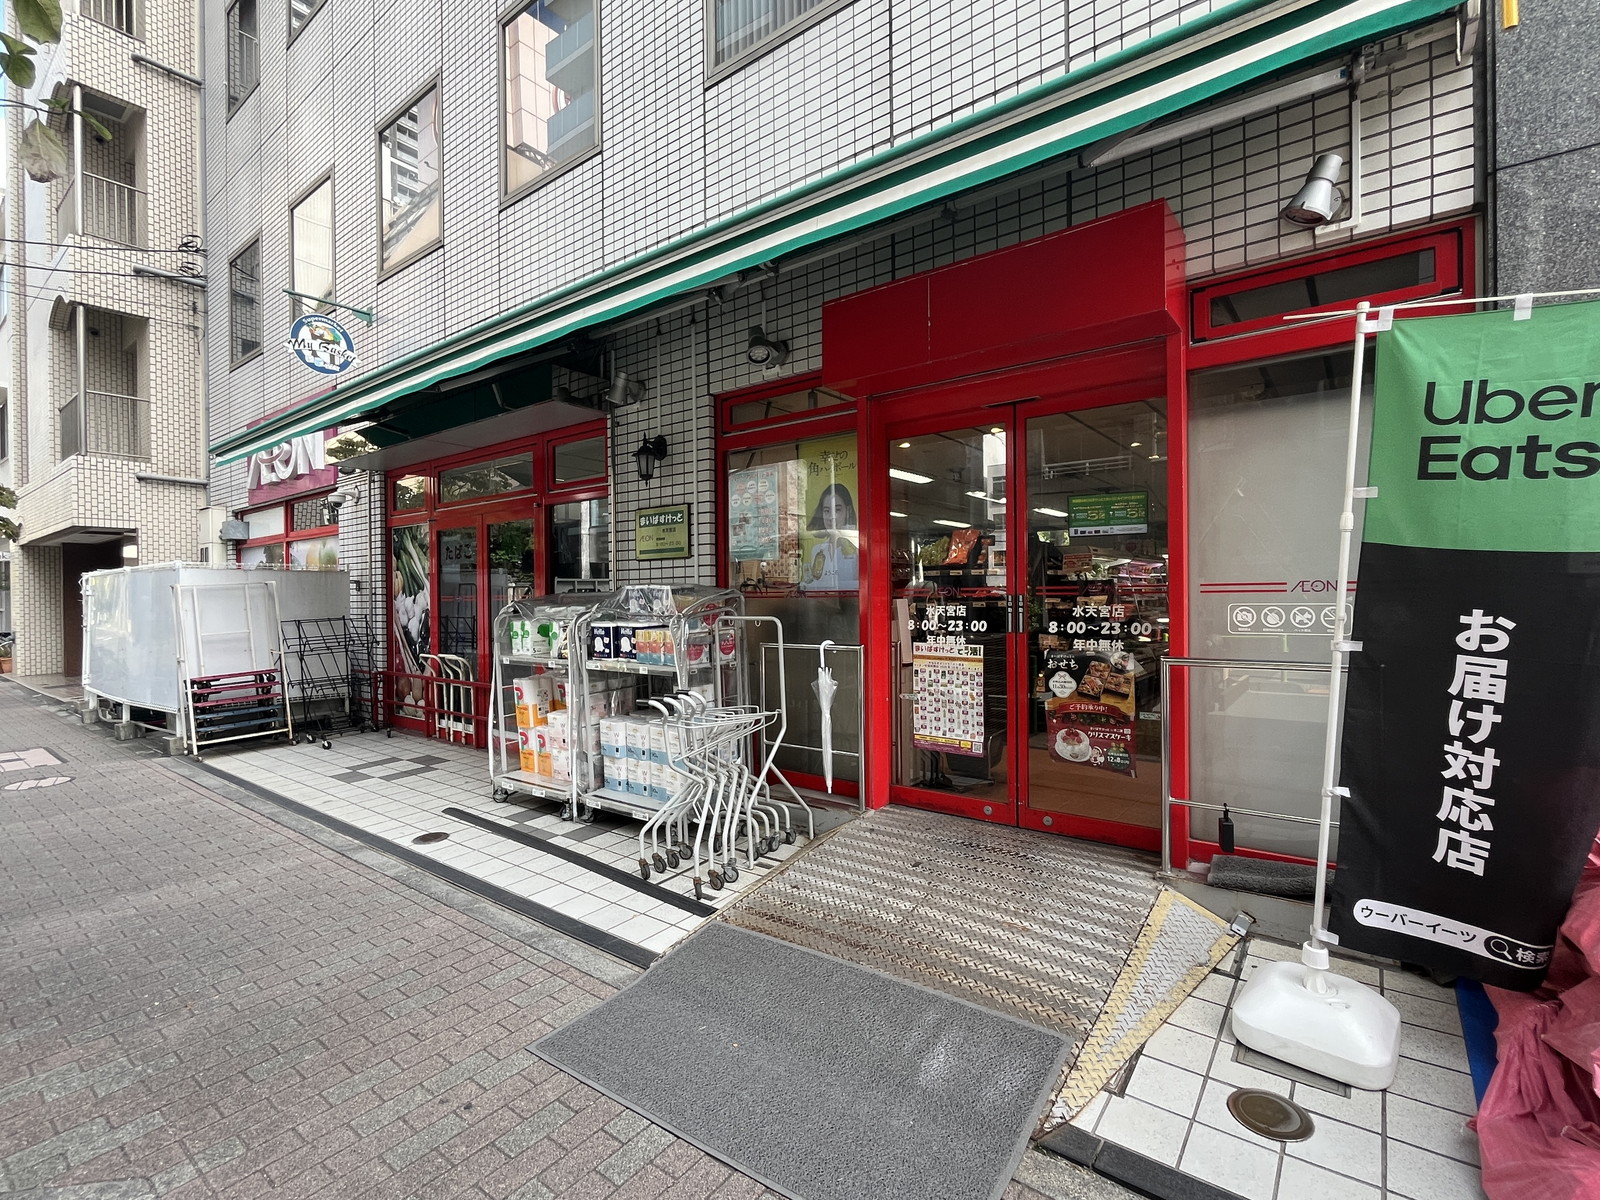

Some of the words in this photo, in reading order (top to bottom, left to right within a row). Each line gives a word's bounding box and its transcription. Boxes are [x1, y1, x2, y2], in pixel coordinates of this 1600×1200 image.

[288, 338, 313, 351] My
[318, 341, 357, 363] Basket
[1424, 379, 1600, 426] Uber
[1417, 435, 1600, 481] Eats
[640, 512, 684, 526] まいばすけっと
[446, 544, 472, 560] たばこ
[926, 605, 967, 617] 水天宮店
[1072, 604, 1125, 618] 水天宮店
[926, 634, 967, 646] 年中無休
[1073, 638, 1125, 652] 年中無休
[1047, 658, 1079, 670] おせち
[1087, 731, 1132, 742] クリスマスケーキ
[1432, 609, 1517, 877] お届け対応店
[1361, 905, 1477, 943] ウーバーイーツ
[1515, 947, 1550, 964] 検索
